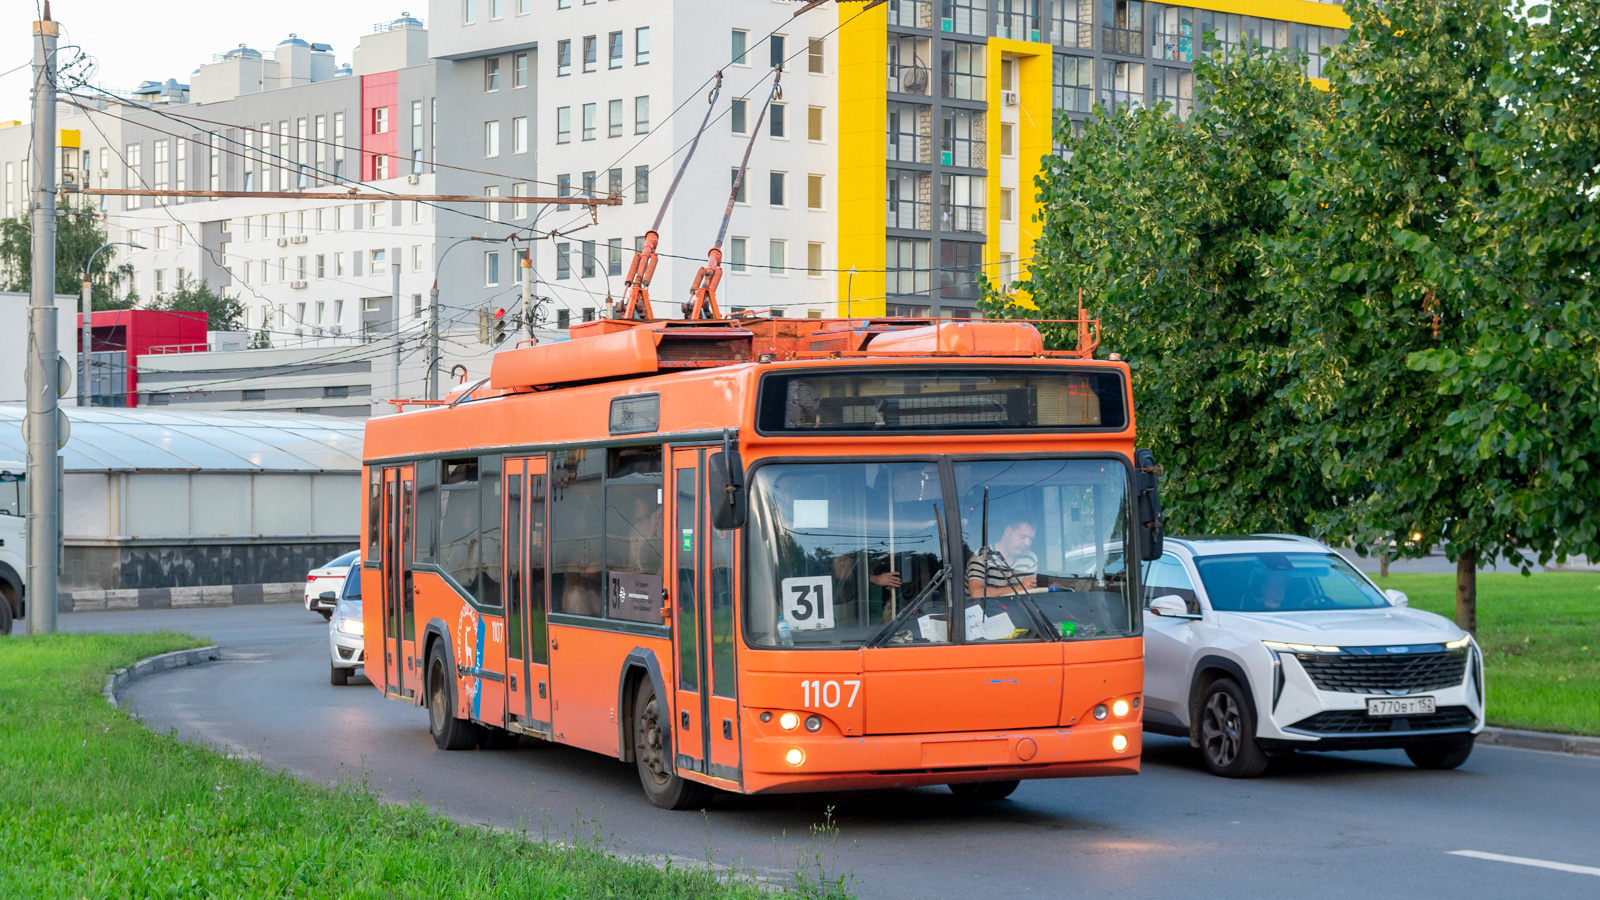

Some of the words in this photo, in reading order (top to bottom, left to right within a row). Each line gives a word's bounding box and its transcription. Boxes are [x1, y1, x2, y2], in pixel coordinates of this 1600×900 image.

[612, 577, 620, 610] 31
[791, 584, 825, 621] 31
[492, 621, 504, 644] 1107
[801, 680, 861, 708] 1107
[1417, 699, 1432, 709] 152
